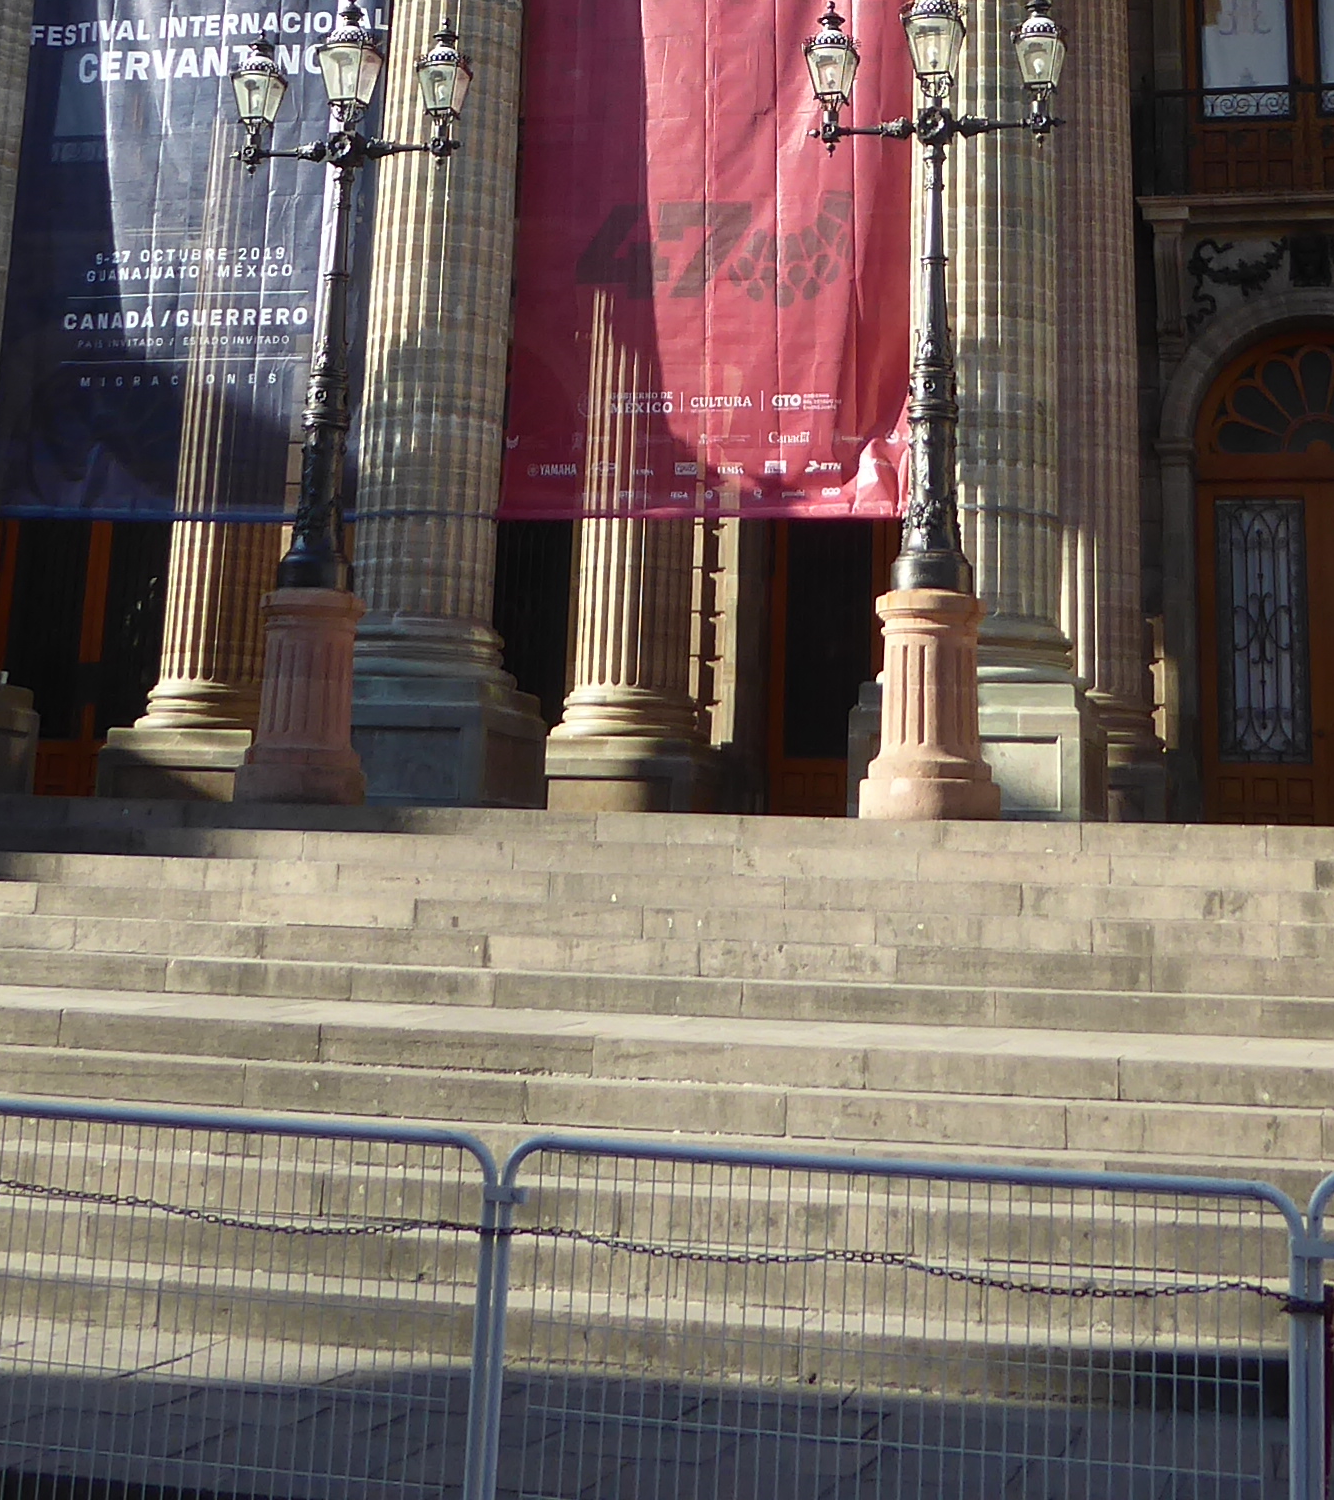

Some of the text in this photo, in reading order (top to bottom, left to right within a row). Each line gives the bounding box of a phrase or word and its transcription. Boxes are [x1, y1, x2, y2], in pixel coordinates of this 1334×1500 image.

[30, 7, 390, 47] FESTIVAL INTERNACIOAL
[78, 41, 323, 84] CERVANTNO
[140, 248, 227, 263] OCTUBRE
[238, 247, 286, 261] 2019
[85, 260, 293, 283] GUANAJUATO MÉXICO
[690, 395, 753, 408] CULTURA
[771, 393, 802, 407] GTO
[539, 463, 578, 476] YAMAHA
